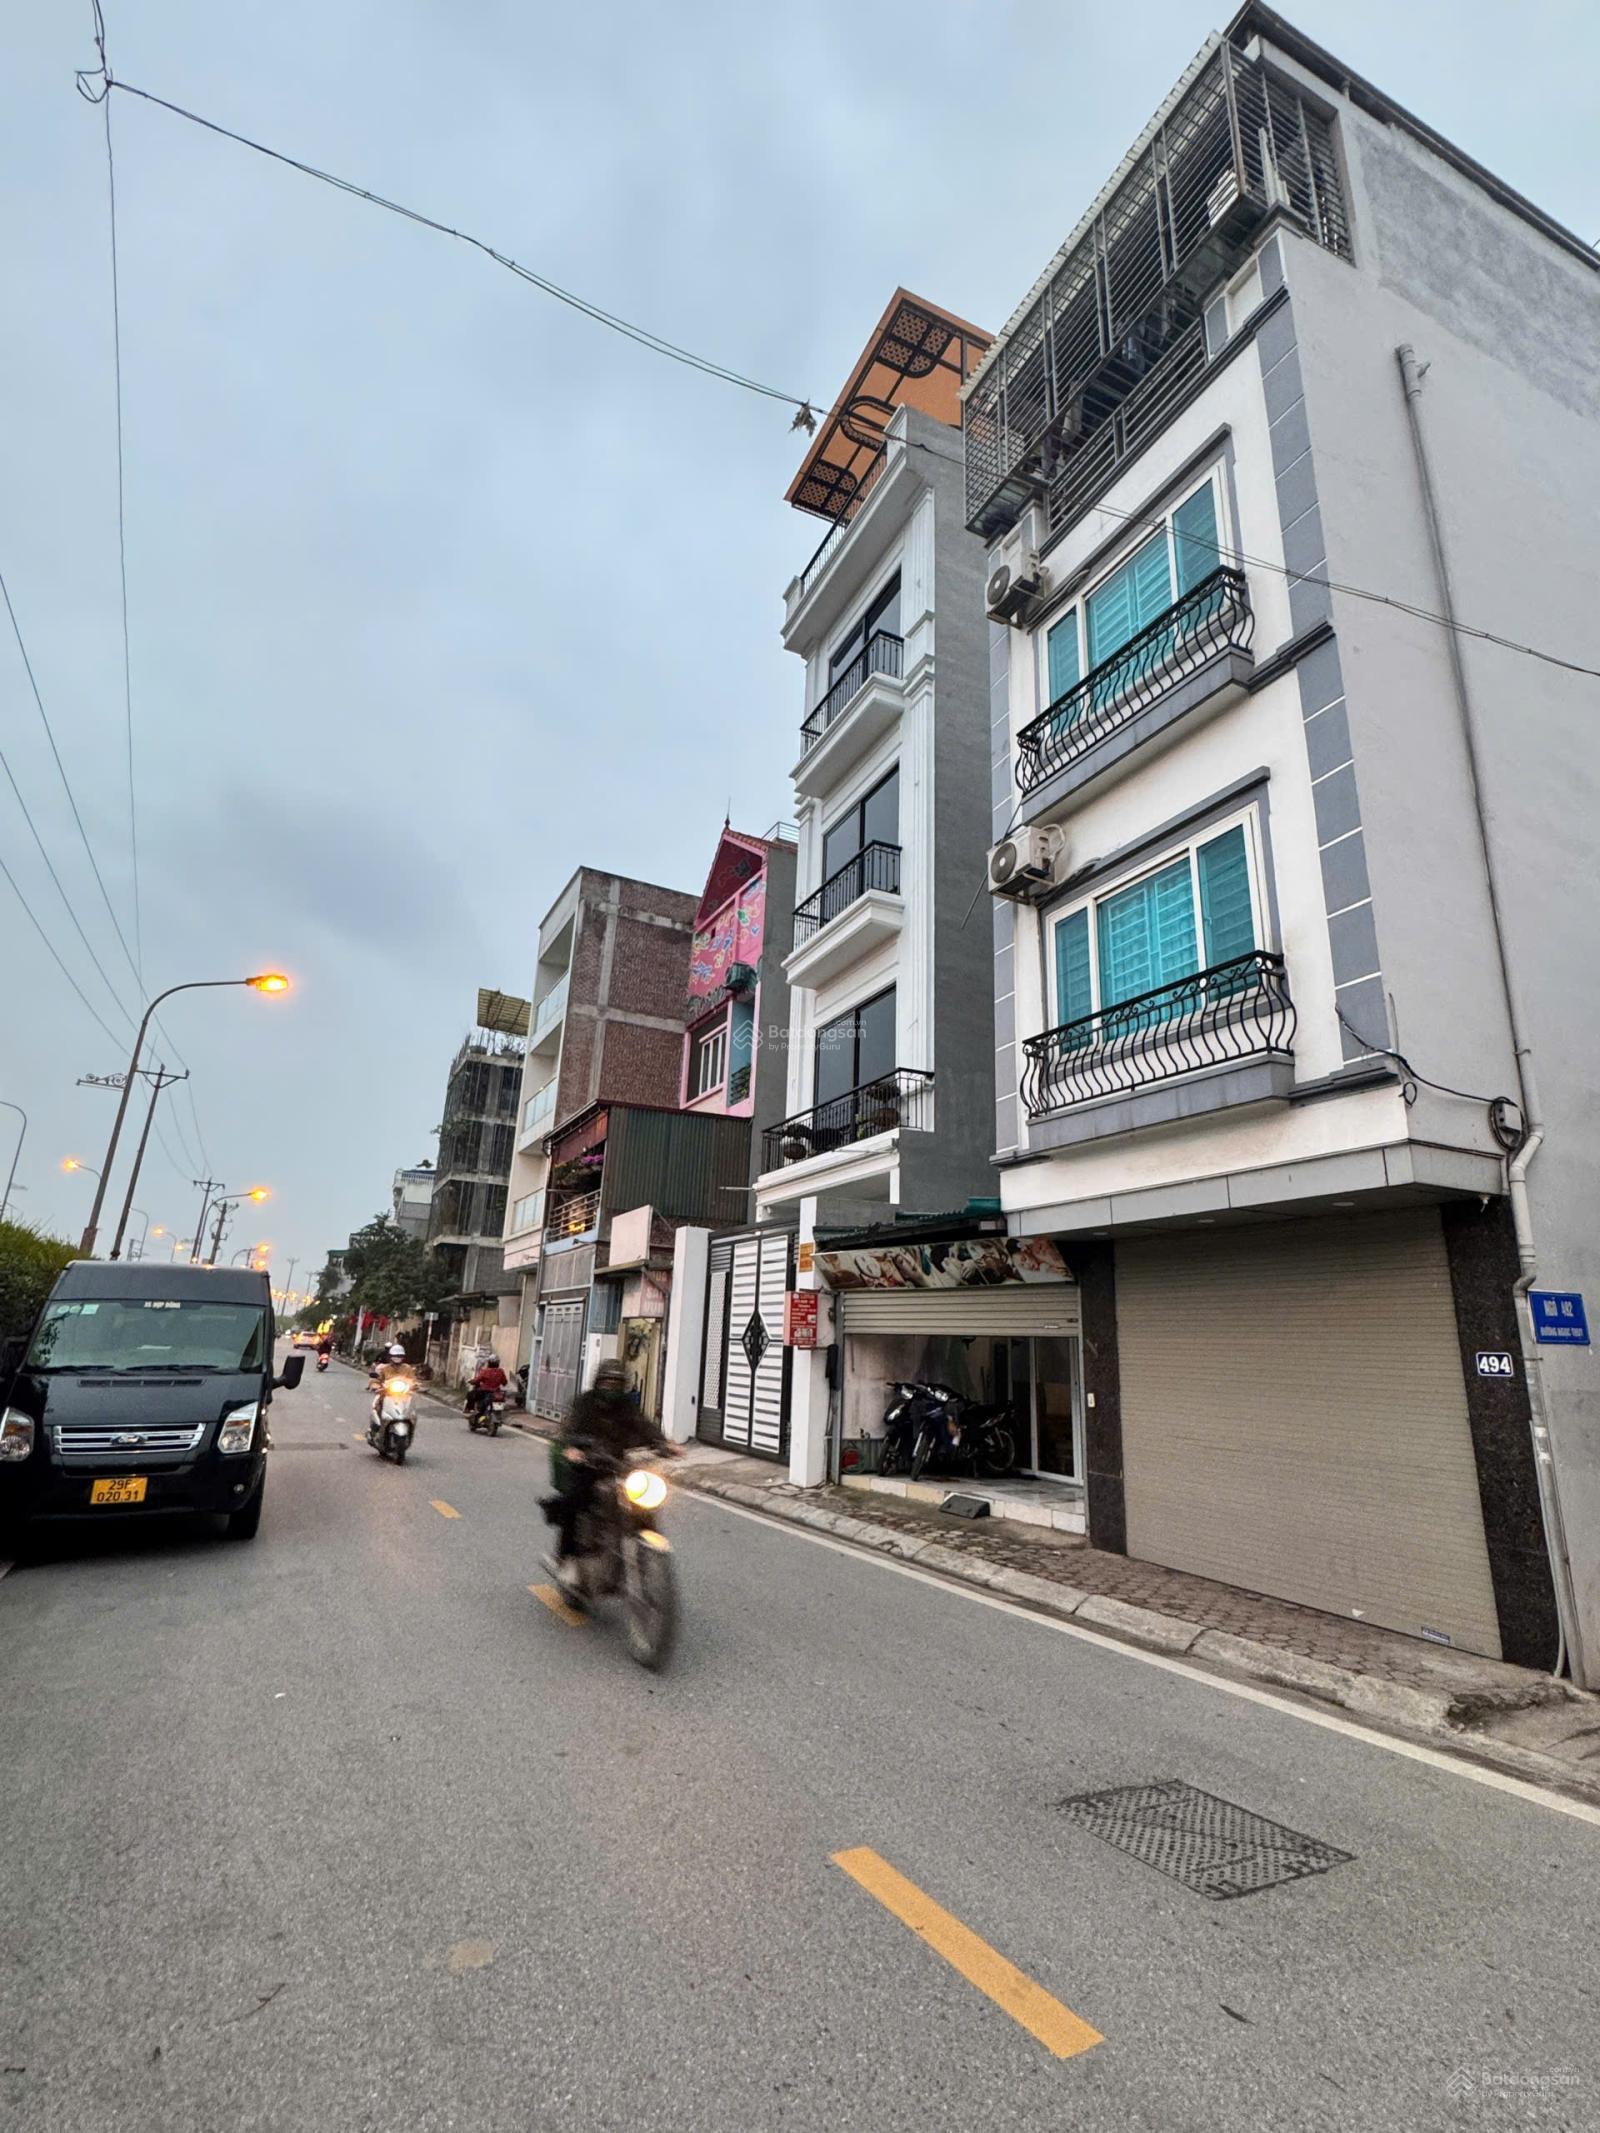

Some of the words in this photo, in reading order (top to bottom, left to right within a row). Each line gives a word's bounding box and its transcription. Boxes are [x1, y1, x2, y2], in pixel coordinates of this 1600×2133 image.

[1479, 1356, 1511, 1374] 494
[109, 1480, 132, 1490] 29F
[97, 1490, 138, 1502] 020.31
